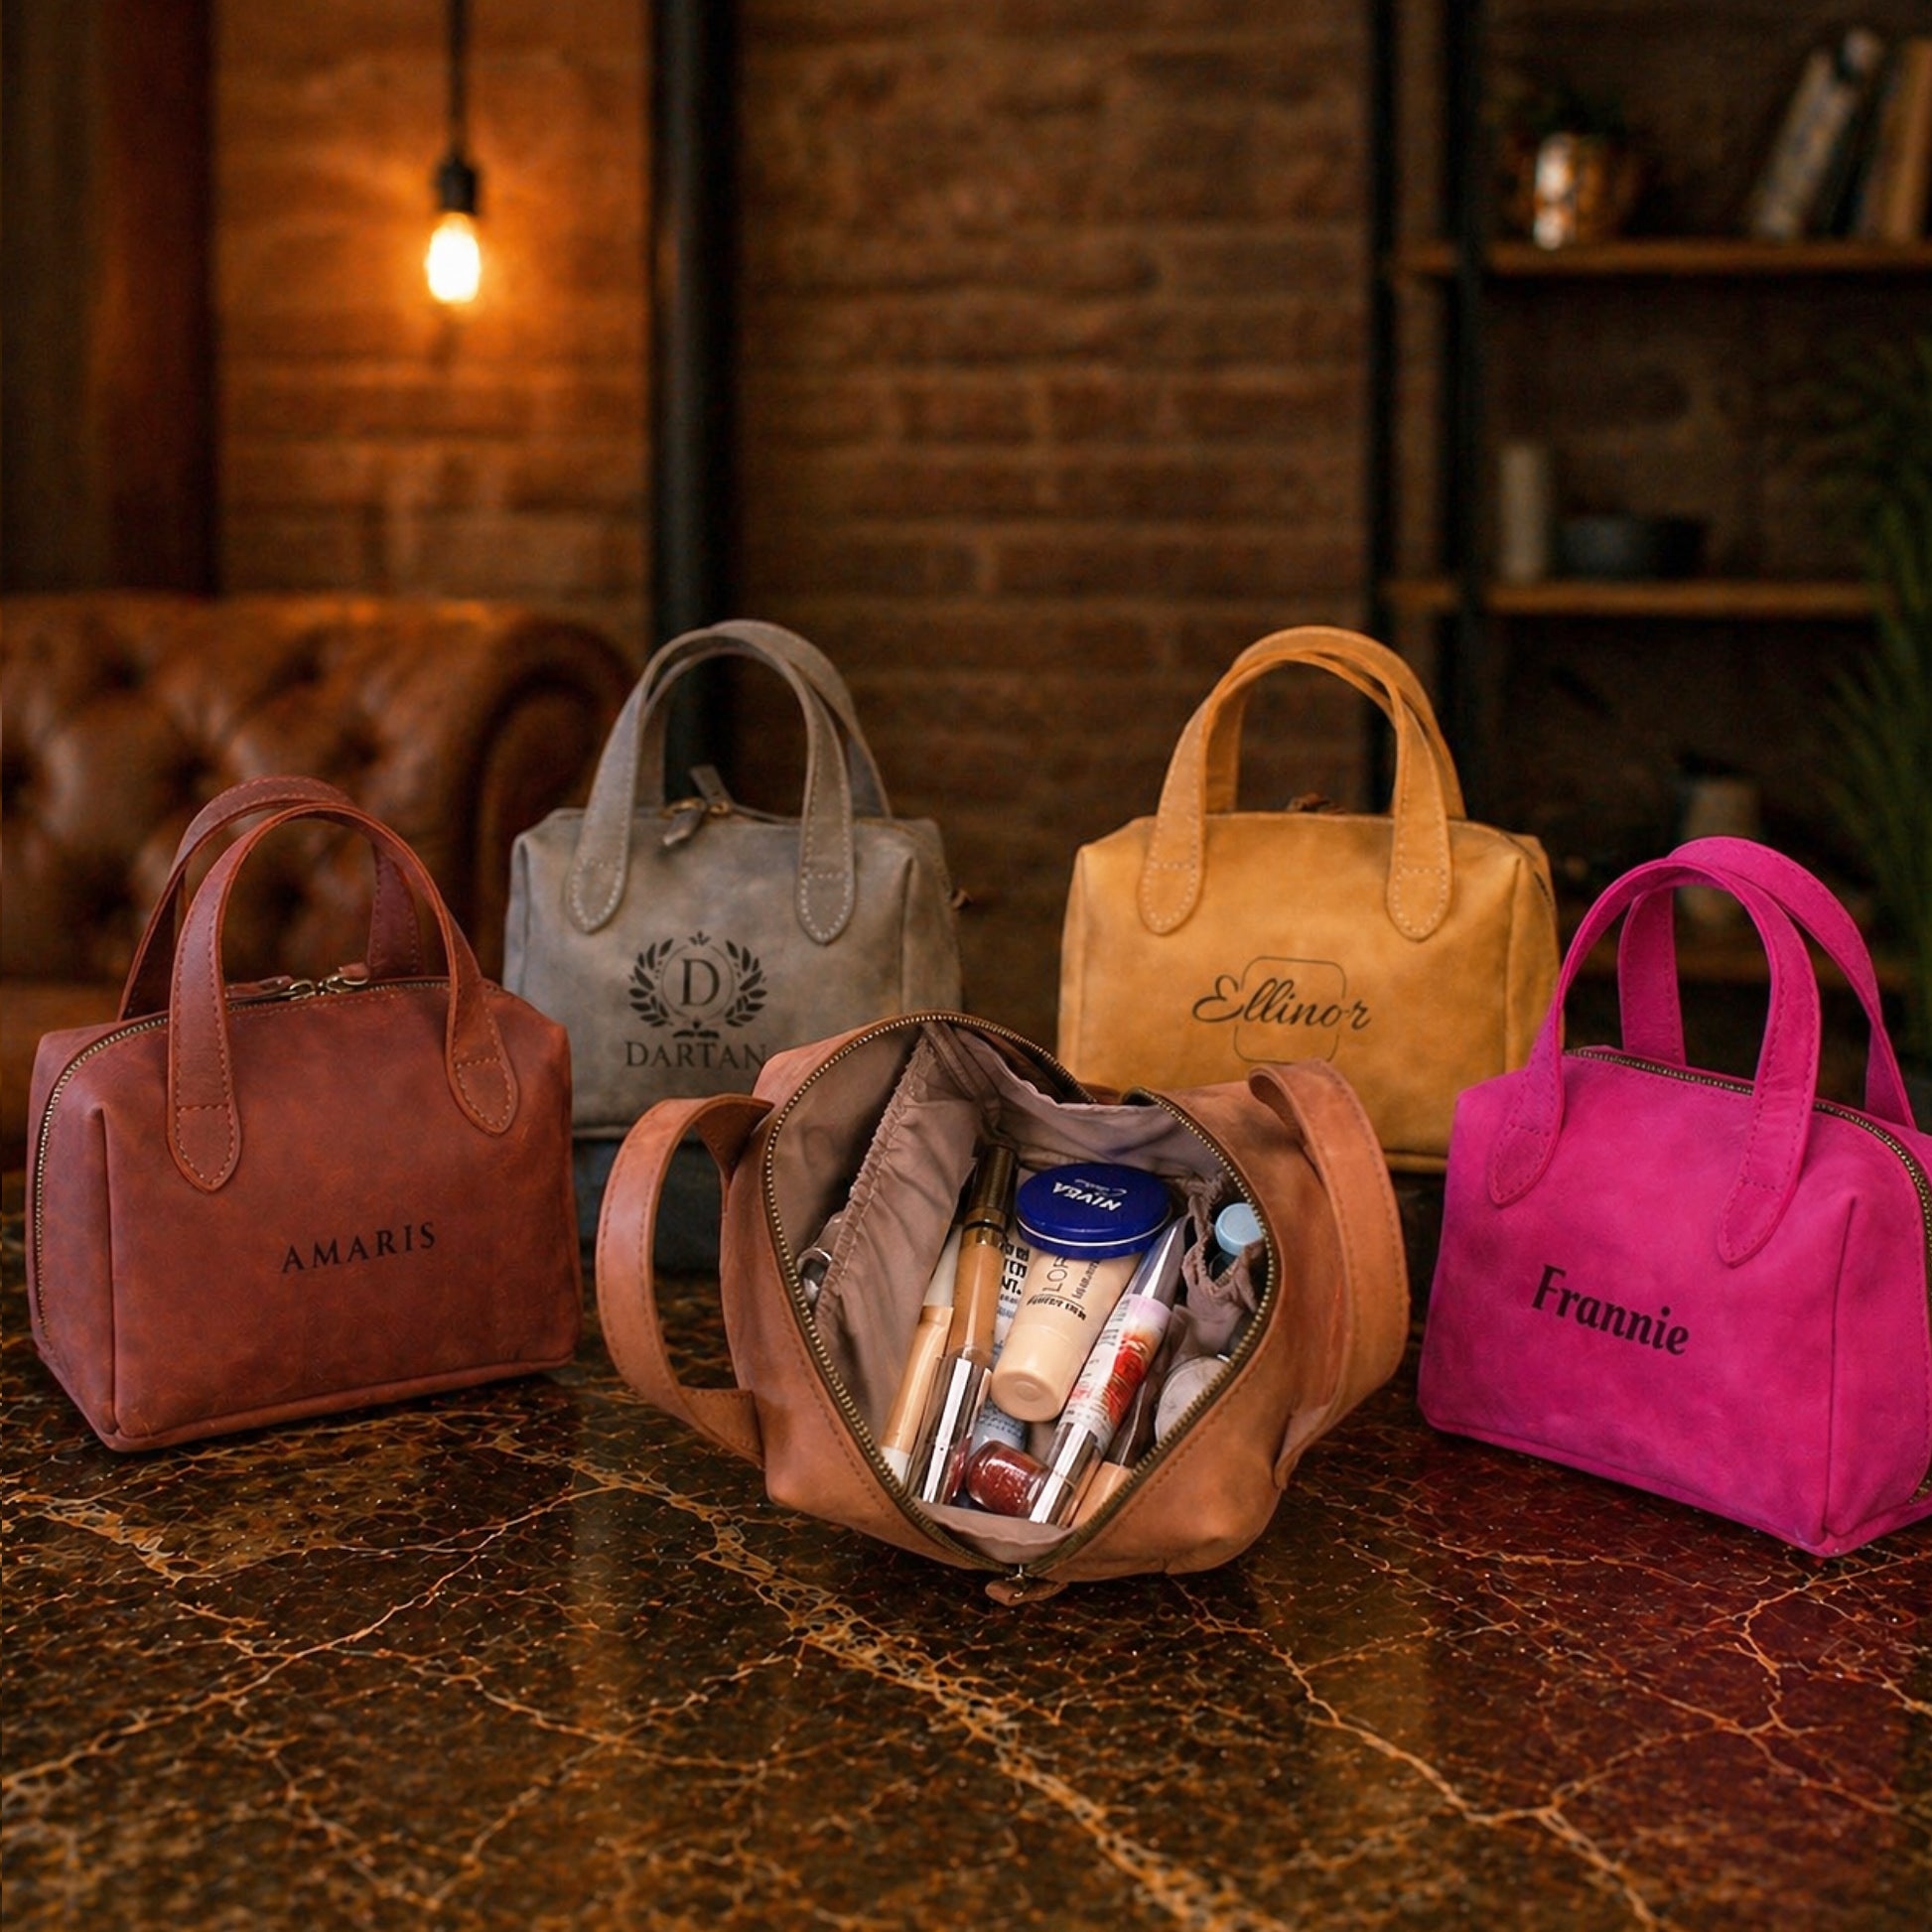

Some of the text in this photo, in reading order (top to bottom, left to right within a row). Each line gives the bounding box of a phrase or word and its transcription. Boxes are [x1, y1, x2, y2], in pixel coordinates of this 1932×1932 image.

[680, 958, 721, 1007] D
[1191, 974, 1371, 1031] Ellinor
[624, 1040, 767, 1070] DARTAN
[1052, 1181, 1123, 1212] NIVEA
[282, 1221, 436, 1274] AMARIS
[1532, 1264, 1690, 1356] Frannie
